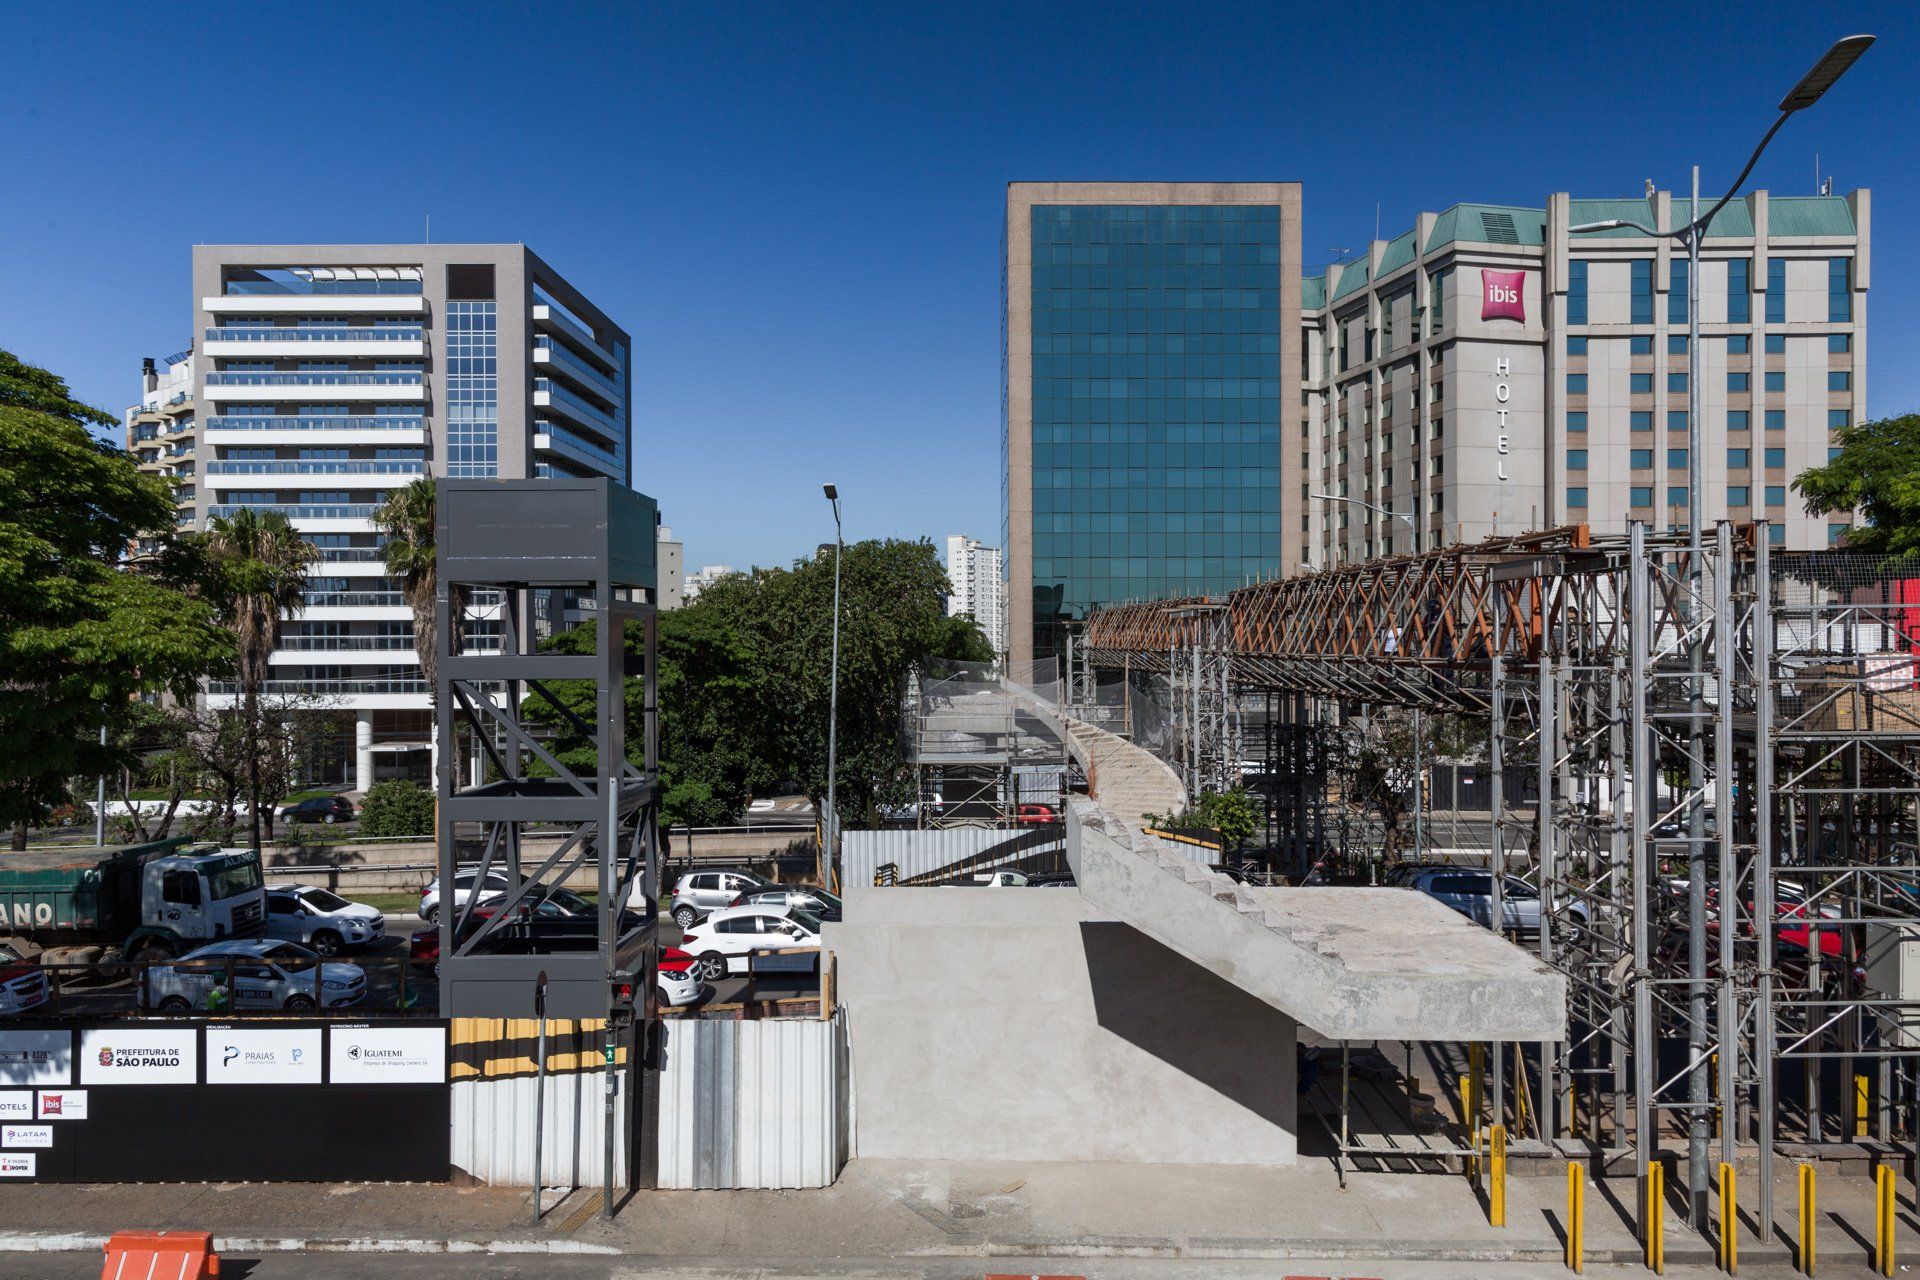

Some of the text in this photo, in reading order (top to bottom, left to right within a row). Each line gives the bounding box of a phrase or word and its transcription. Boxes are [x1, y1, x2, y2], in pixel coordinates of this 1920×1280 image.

[1489, 284, 1518, 304] ibis
[1496, 357, 1510, 480] HOTEL
[224, 852, 255, 868] ALANO
[116, 1048, 180, 1056] PREFEITURA DE
[245, 1052, 275, 1060] PRAIAS
[364, 1049, 403, 1057] IGUATEMI
[116, 1056, 180, 1067] SÃO PAULO
[45, 1099, 60, 1109] ibis
